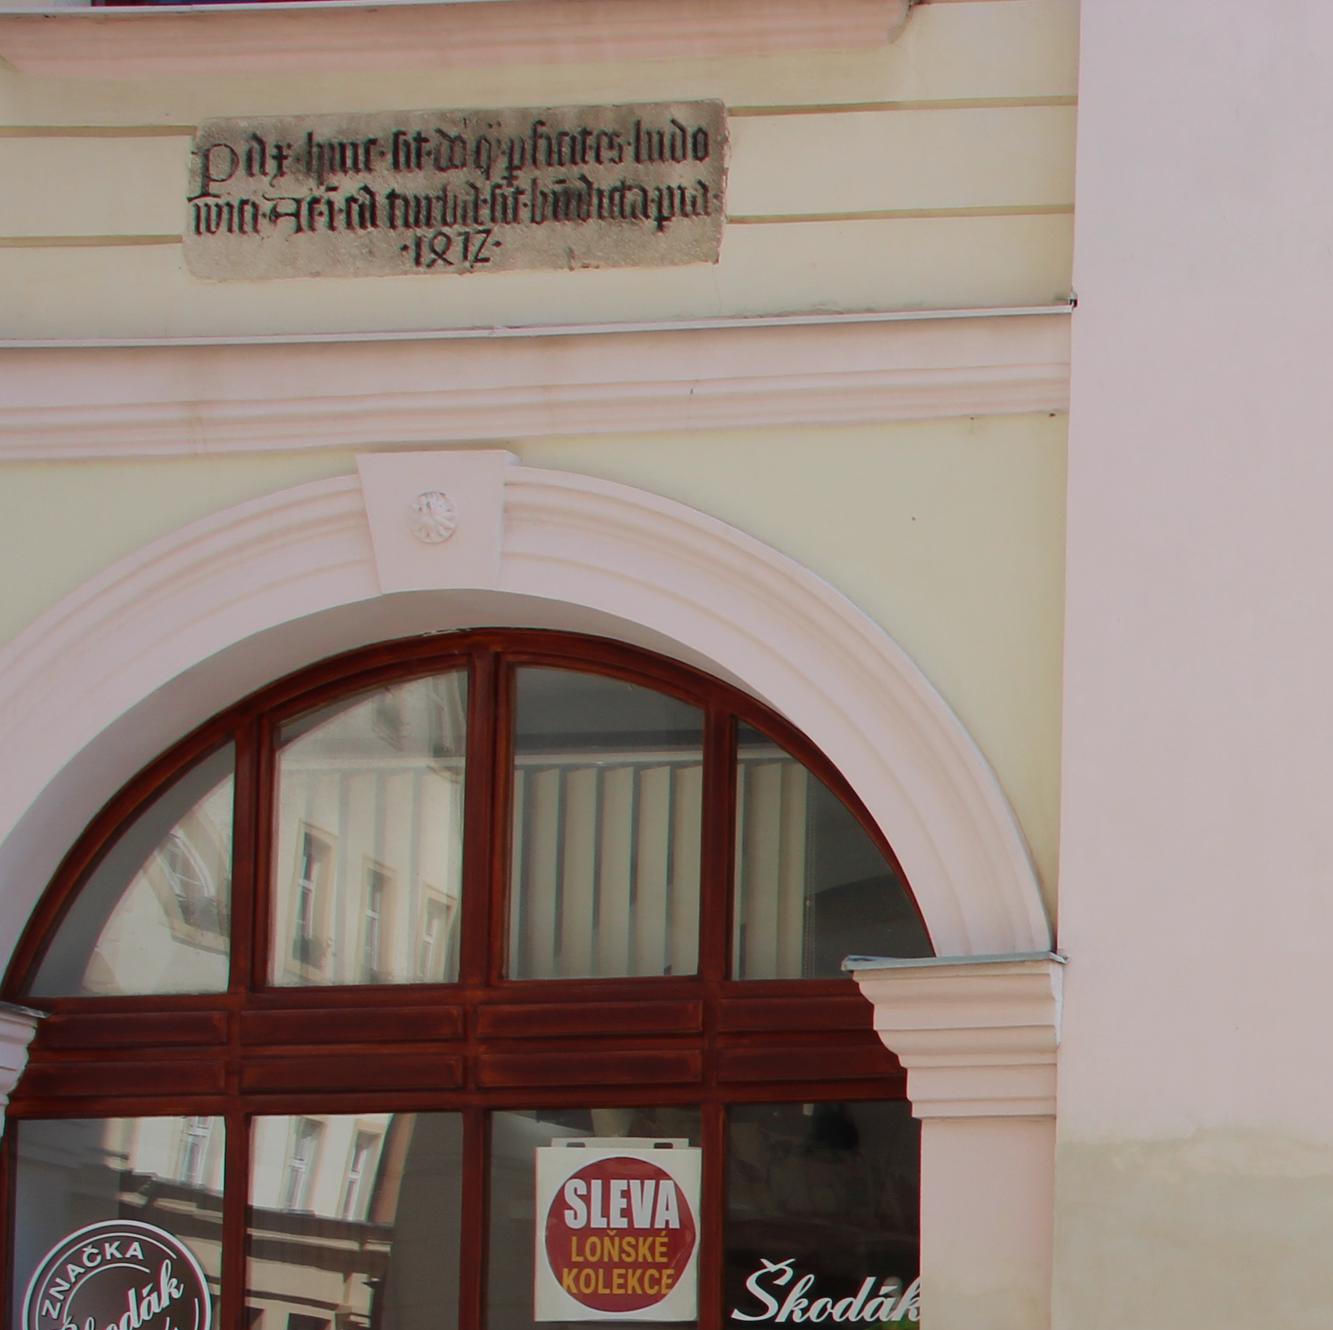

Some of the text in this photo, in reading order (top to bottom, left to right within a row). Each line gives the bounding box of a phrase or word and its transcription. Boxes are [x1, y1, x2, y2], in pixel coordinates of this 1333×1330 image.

[563, 1177, 681, 1230] SLEVA
[570, 1229, 670, 1264] LOŇSKÉ
[42, 1240, 145, 1320] ZNAČKA
[562, 1267, 676, 1296] KOLEKCE
[731, 1257, 921, 1324] Škodák
